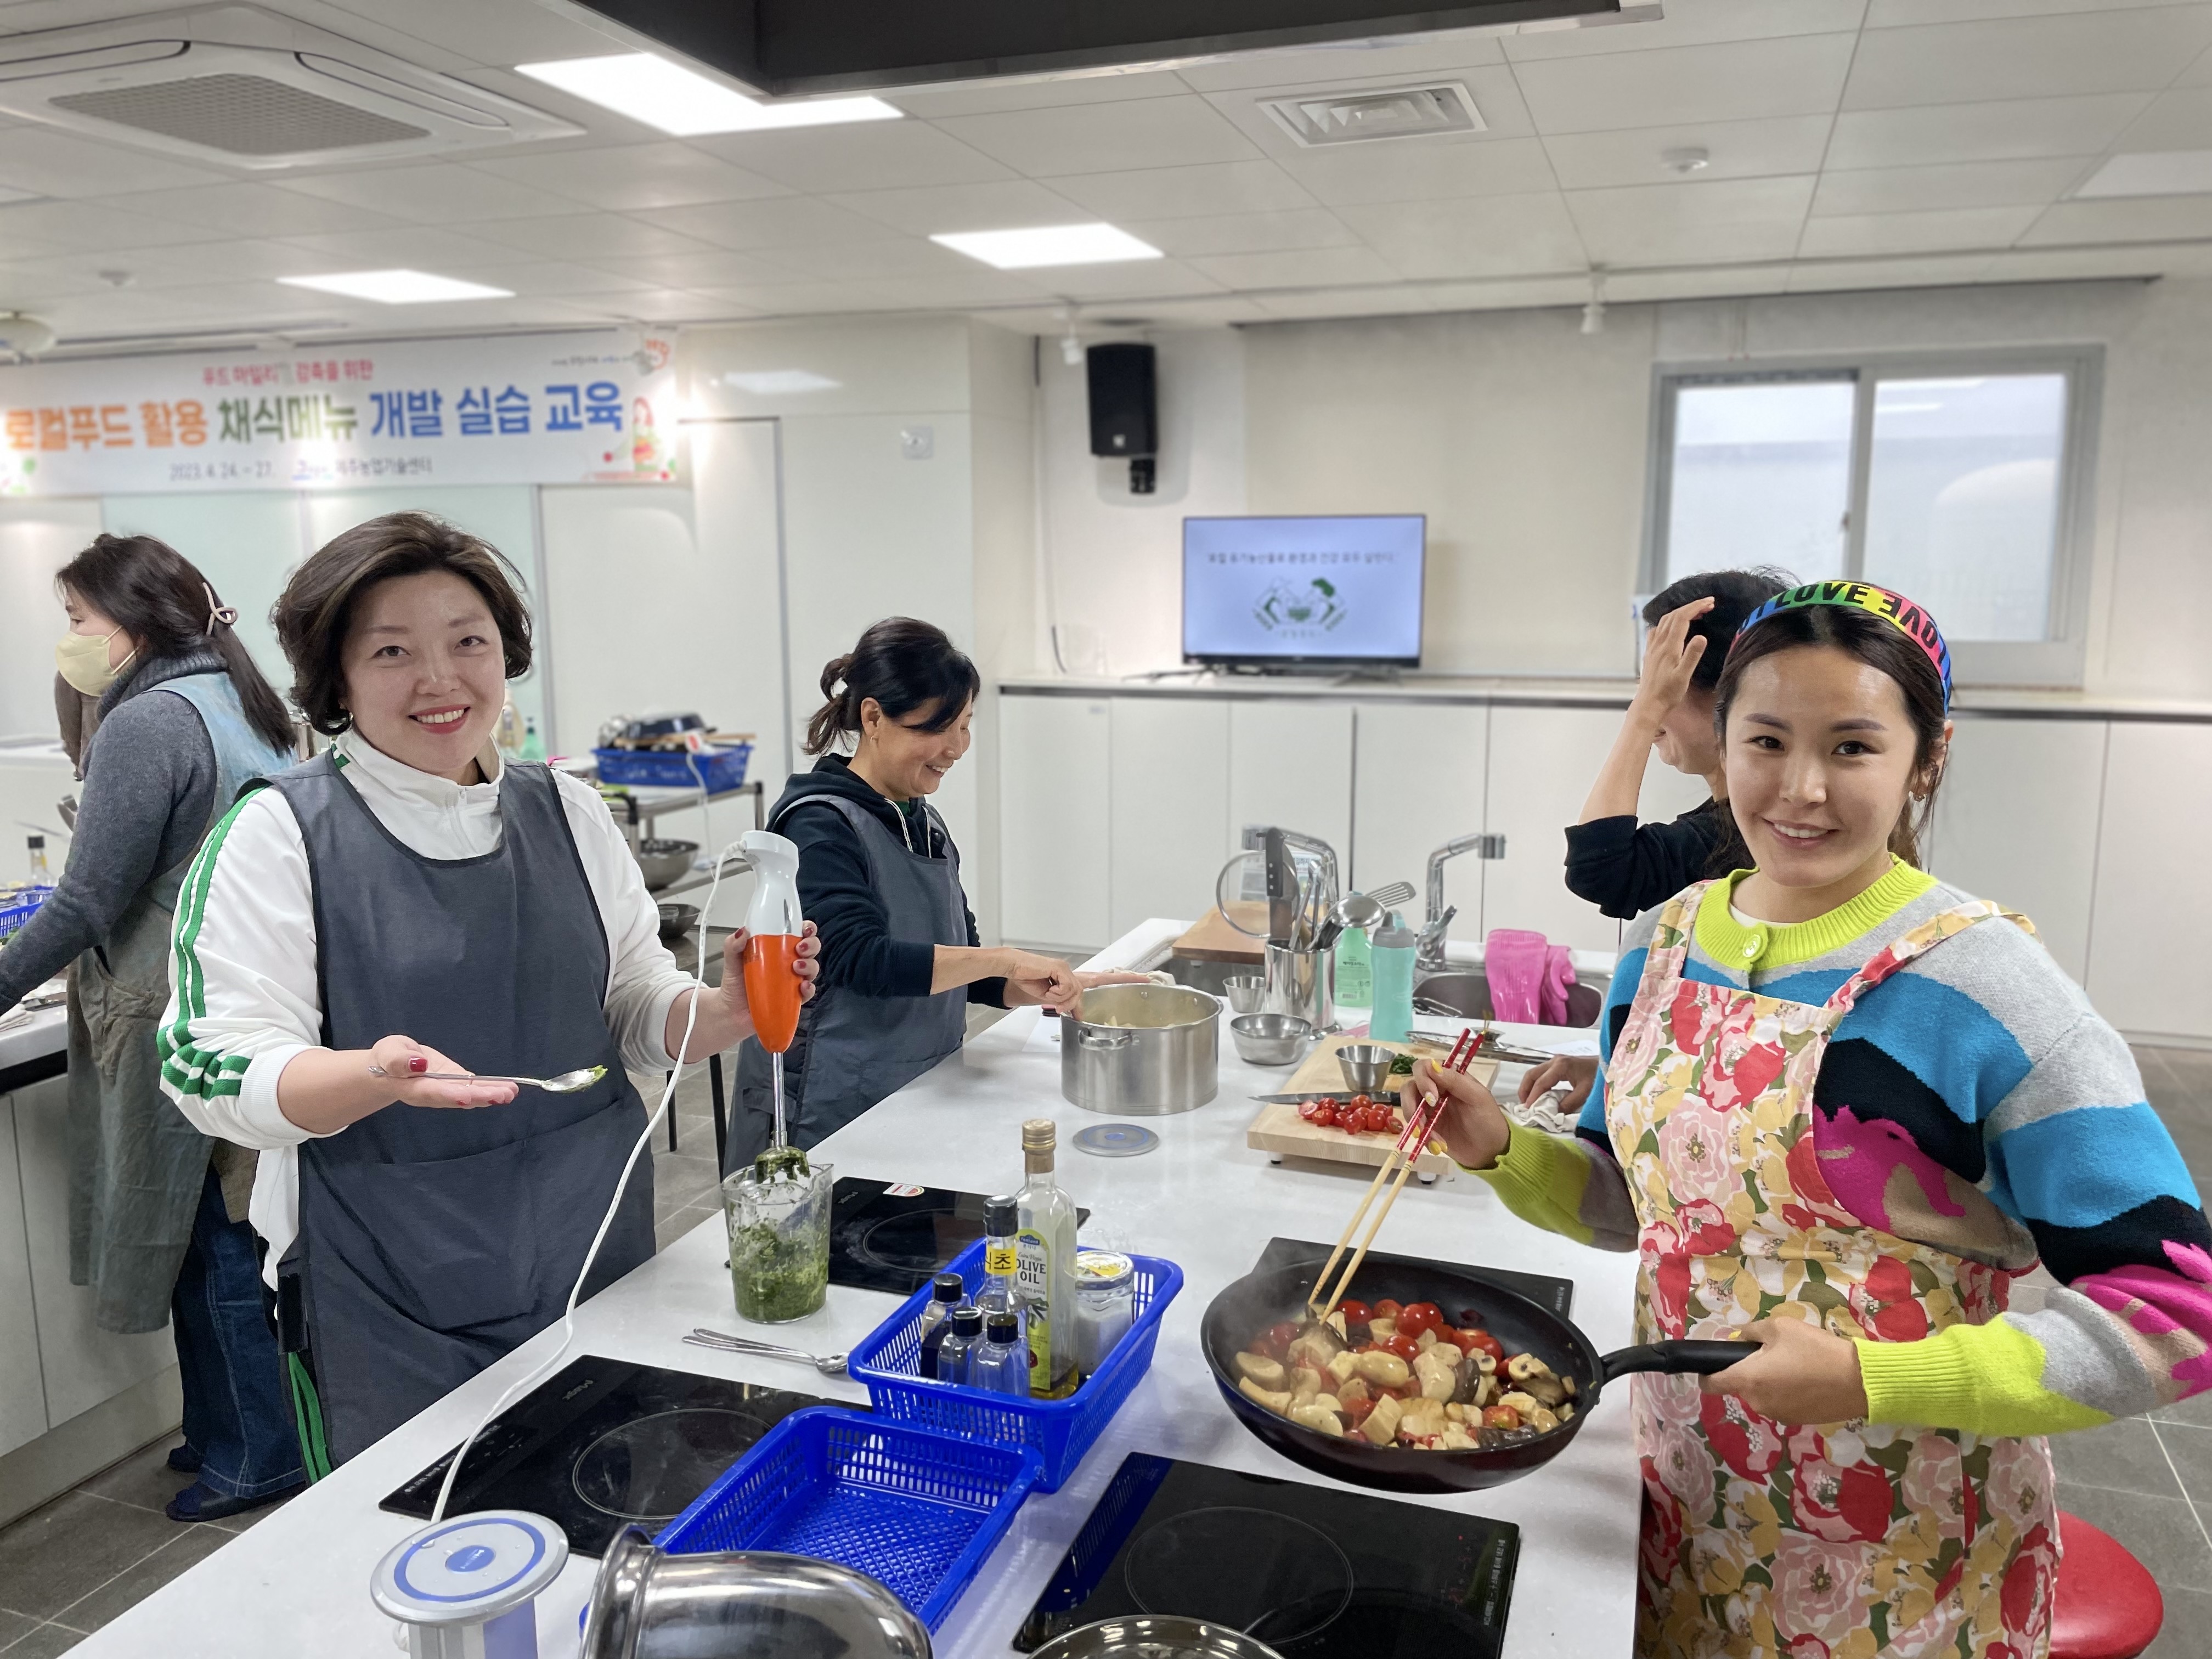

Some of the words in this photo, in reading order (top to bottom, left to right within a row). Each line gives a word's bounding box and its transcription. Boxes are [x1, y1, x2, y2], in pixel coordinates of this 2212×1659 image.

[233, 363, 293, 386] 마일리
[5, 404, 134, 452] 로컬푸드
[140, 399, 208, 448] 활용
[218, 392, 358, 444] 채식메뉴
[369, 388, 444, 438] 개발
[456, 384, 531, 436] 실습
[545, 380, 623, 432] 교육
[1774, 582, 1870, 608] LOVE
[1878, 592, 1946, 667] LOVE
[1016, 1258, 1046, 1274] OLIVE
[1020, 1271, 1040, 1284] OIL
